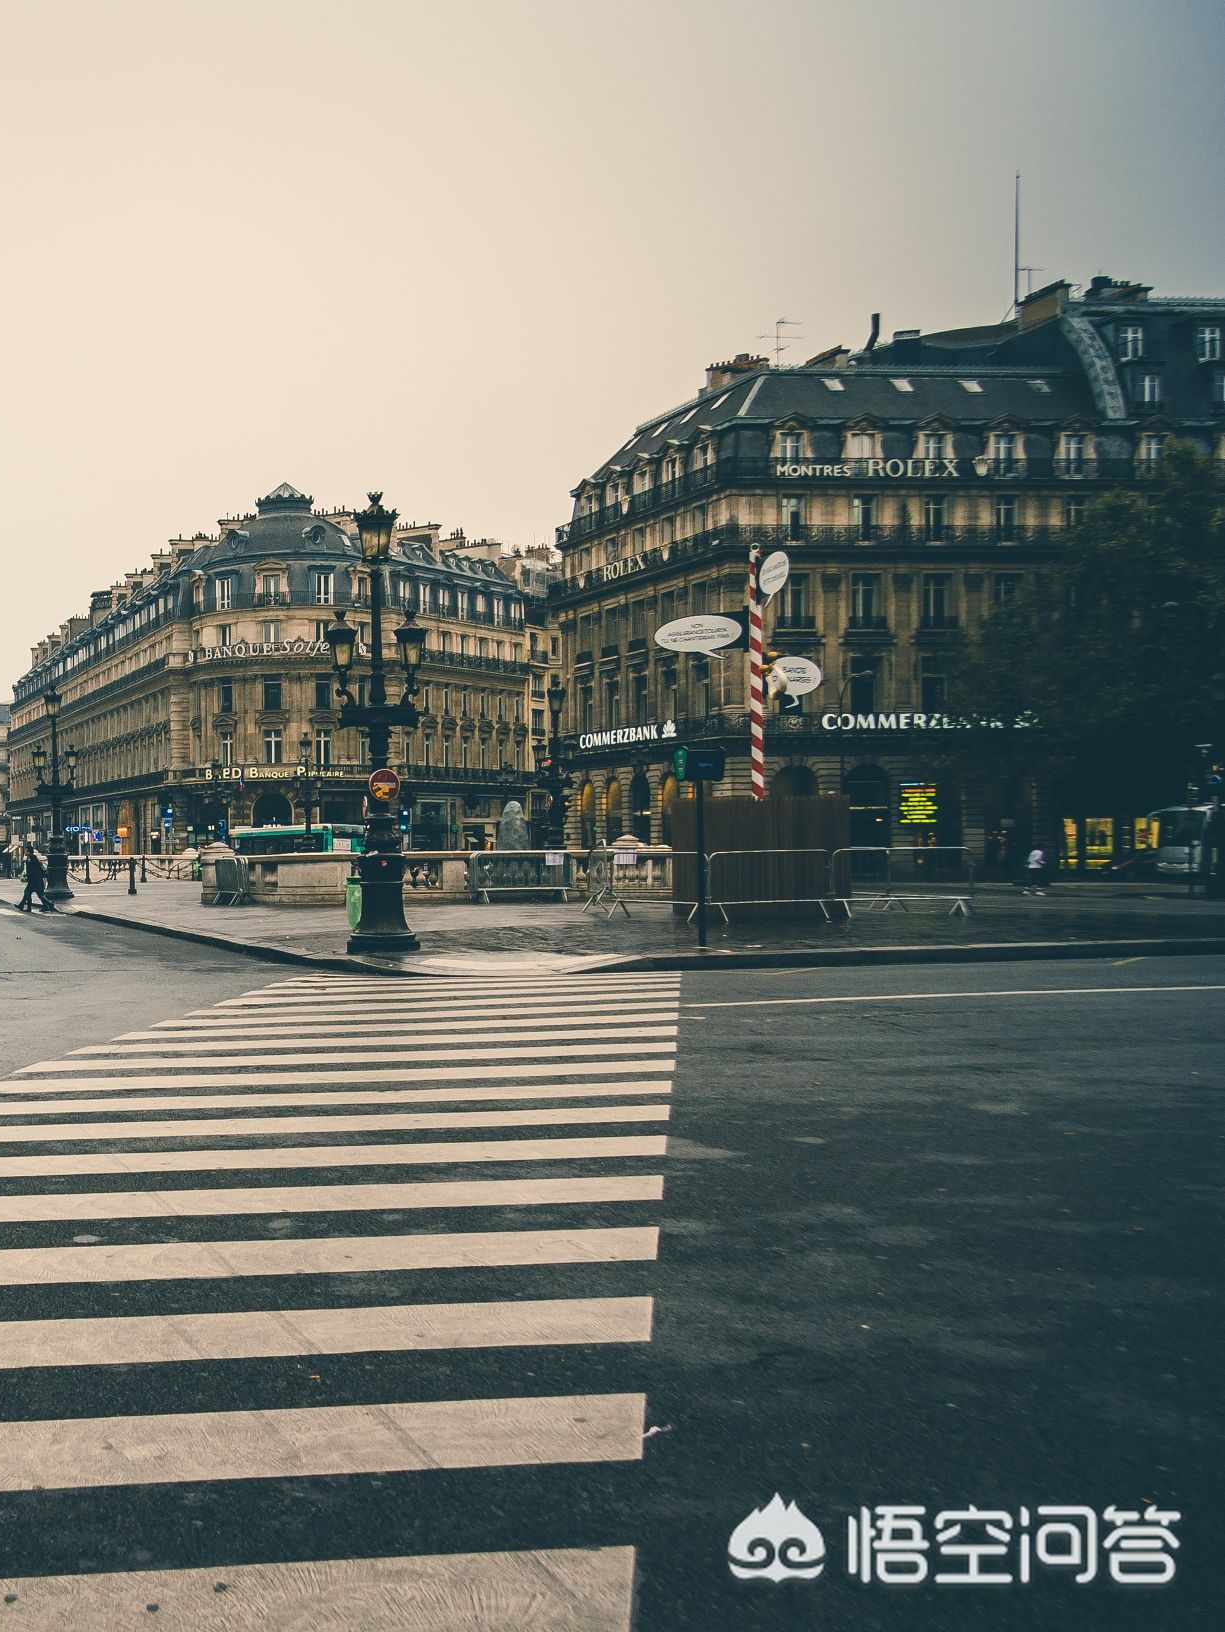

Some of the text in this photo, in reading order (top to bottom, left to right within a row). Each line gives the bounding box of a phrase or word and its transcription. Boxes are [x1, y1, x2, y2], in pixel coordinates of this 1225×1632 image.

[776, 458, 960, 477] MONTRES ROLEX
[603, 553, 646, 582] ROLEX
[205, 642, 273, 660] BANQUE
[579, 724, 658, 749] COMMERZBANK
[205, 767, 242, 780] BED
